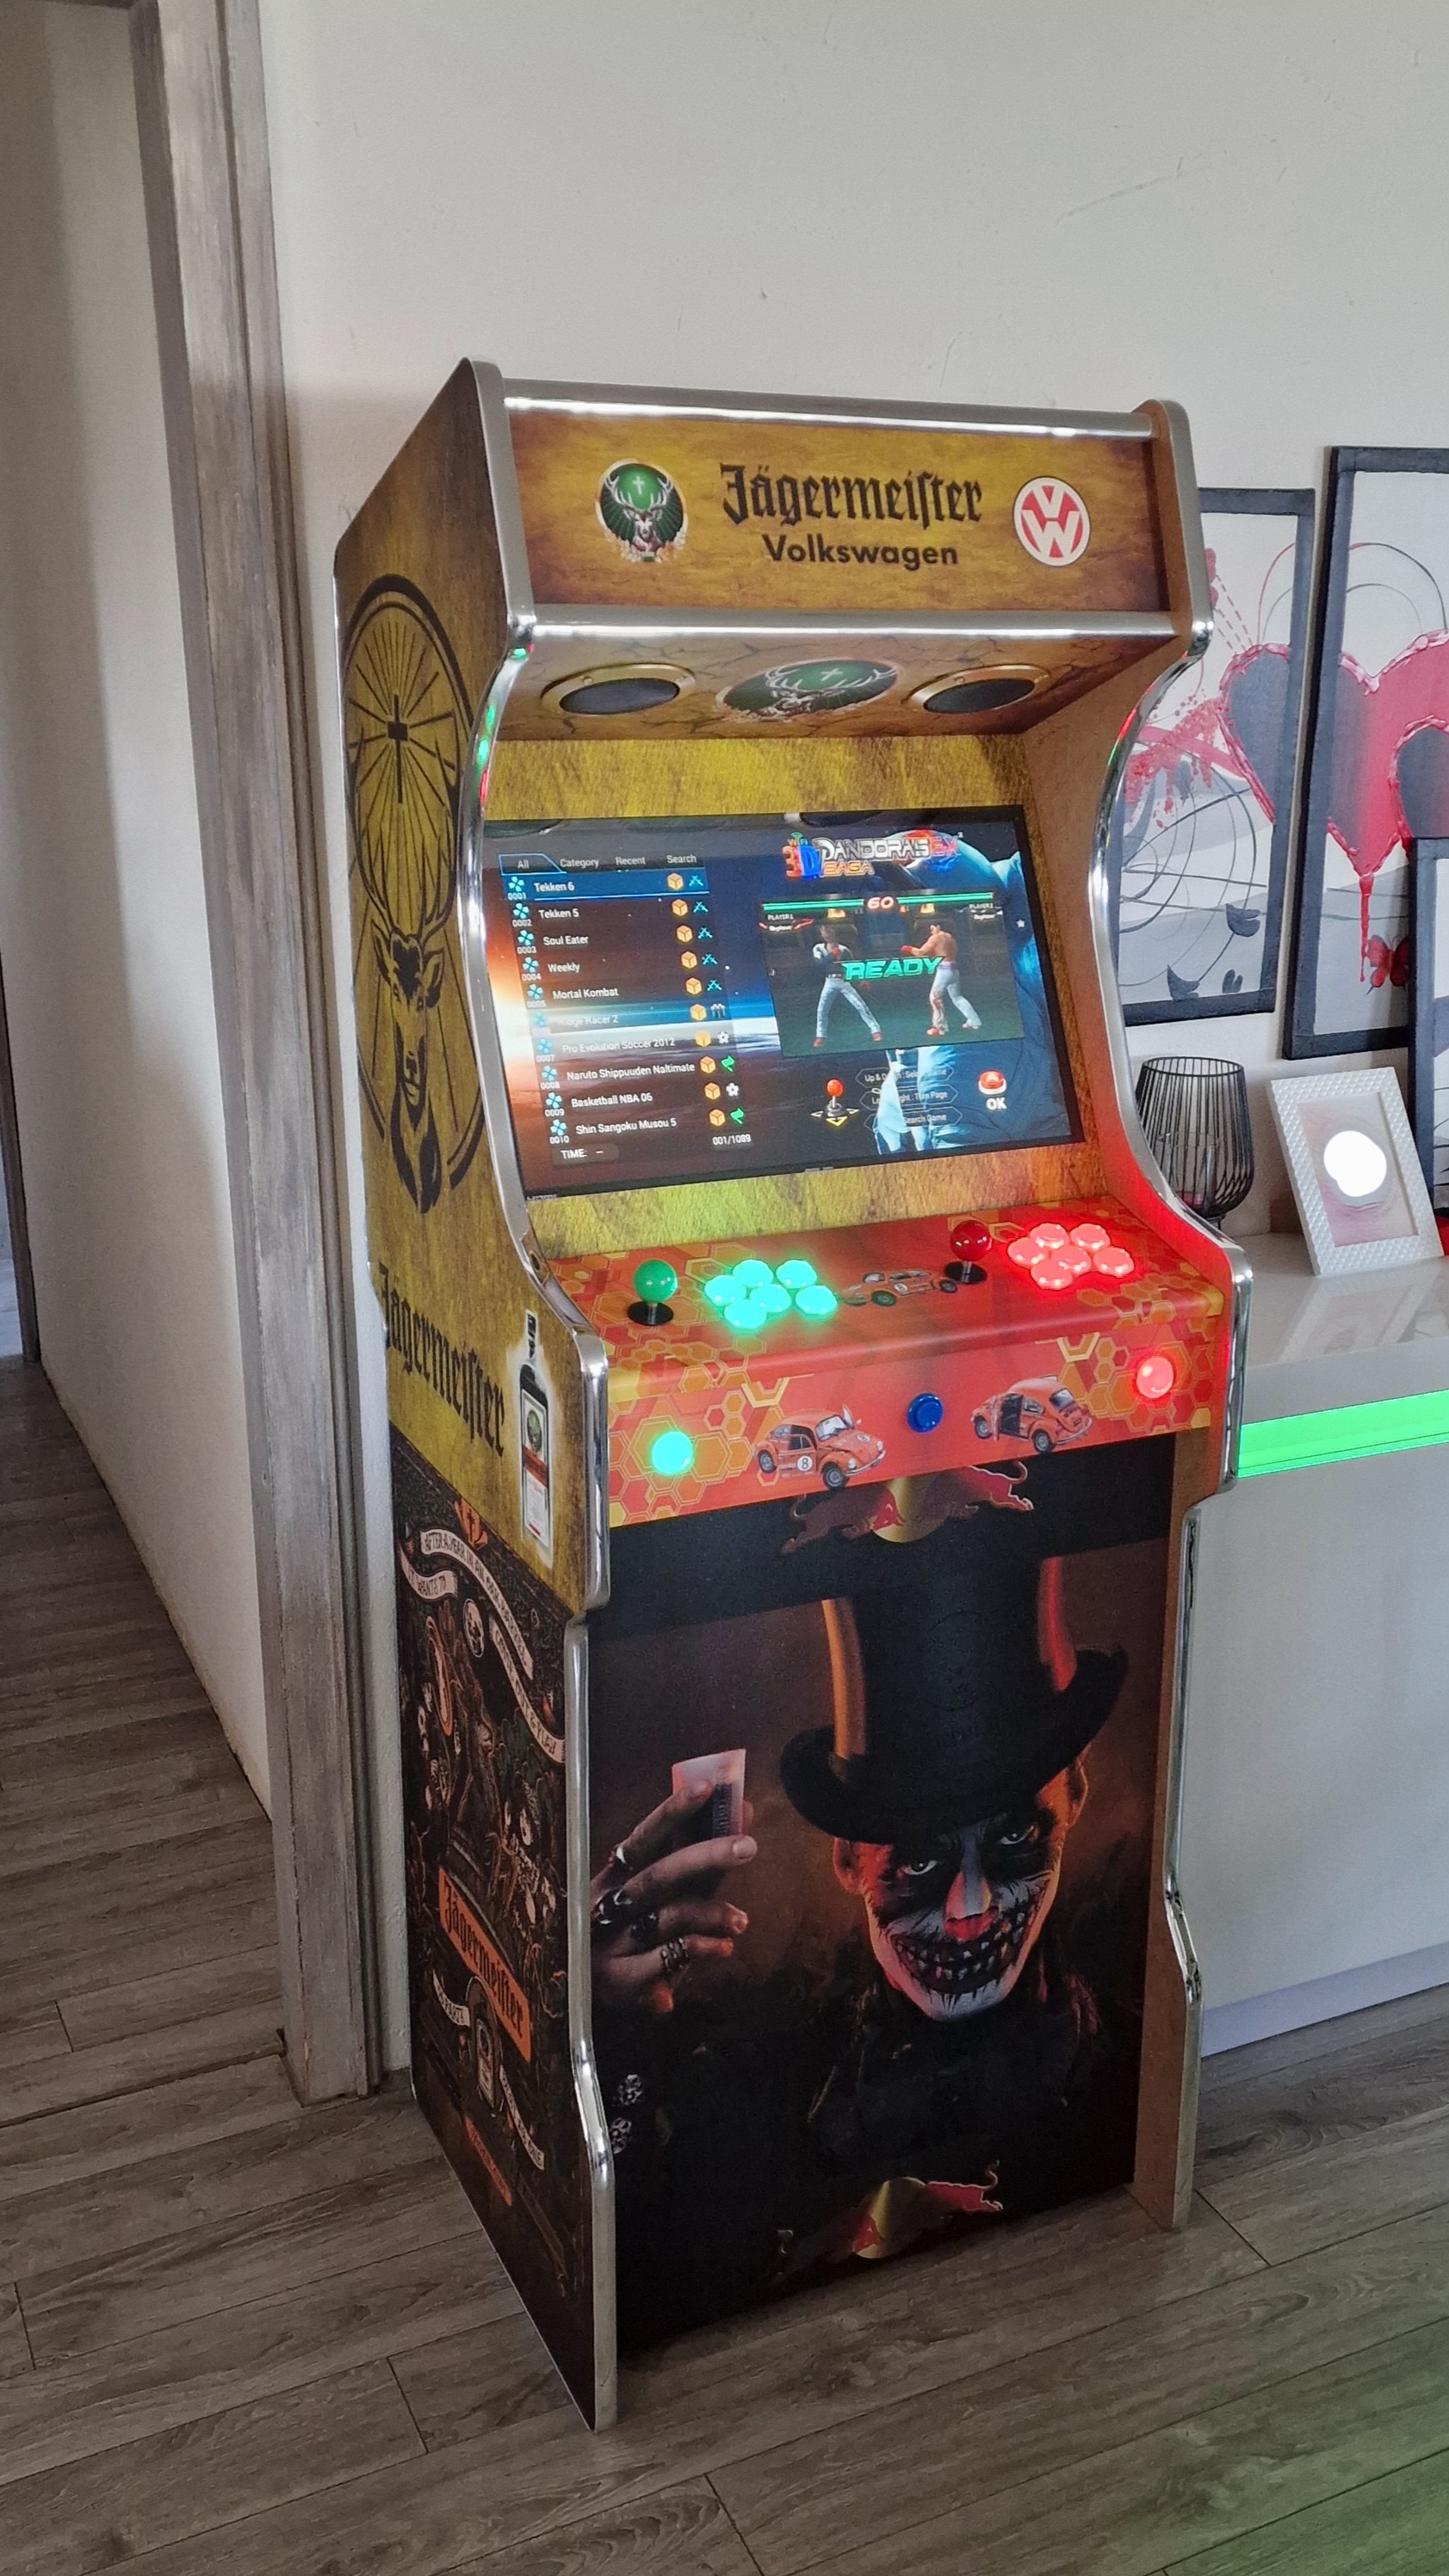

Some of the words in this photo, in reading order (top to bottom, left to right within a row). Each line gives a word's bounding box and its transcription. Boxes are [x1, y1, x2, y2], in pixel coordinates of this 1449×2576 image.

[762, 533, 958, 572] Volkswagen
[517, 859, 529, 870] All
[560, 858, 599, 870] Category
[616, 856, 646, 866] Recent
[666, 854, 697, 864] Search
[821, 861, 876, 876] SAGA
[534, 882, 567, 893] Tekken
[567, 882, 575, 891] 6
[507, 892, 527, 901] 0001
[538, 909, 571, 920] Tekken
[572, 908, 579, 918] 5
[511, 919, 532, 927] 0002
[543, 936, 565, 946] Soul
[566, 934, 589, 944] Eater
[517, 946, 537, 955] 0003
[548, 962, 580, 974] Weekly
[841, 956, 945, 981] READY
[522, 973, 542, 981] 0004
[553, 988, 583, 1000] Mortal
[583, 987, 619, 999] Kombat
[585, 1016, 610, 1025] Racer
[611, 1014, 619, 1023] 2
[562, 1043, 578, 1054] Pro
[579, 1042, 620, 1053] Evolution
[622, 1040, 651, 1050] Soccer
[653, 1037, 676, 1048] 2012
[567, 1068, 599, 1081] Naruto
[599, 1065, 653, 1081] Shippuuden
[864, 1074, 875, 1083] Up
[571, 1094, 618, 1108] Basketball
[619, 1093, 641, 1105] NBA
[931, 1091, 948, 1099] Page
[987, 1097, 1007, 1112] OK
[545, 1108, 565, 1118] 0009
[576, 1123, 598, 1136] Shin
[598, 1121, 638, 1134] Sangoku
[638, 1119, 670, 1130] Musou
[670, 1118, 678, 1128] 5
[549, 1136, 570, 1145] 0010
[802, 1458, 808, 1470] 8
[424, 1532, 443, 1551] AFTER
[449, 1535, 466, 1558] YEAR
